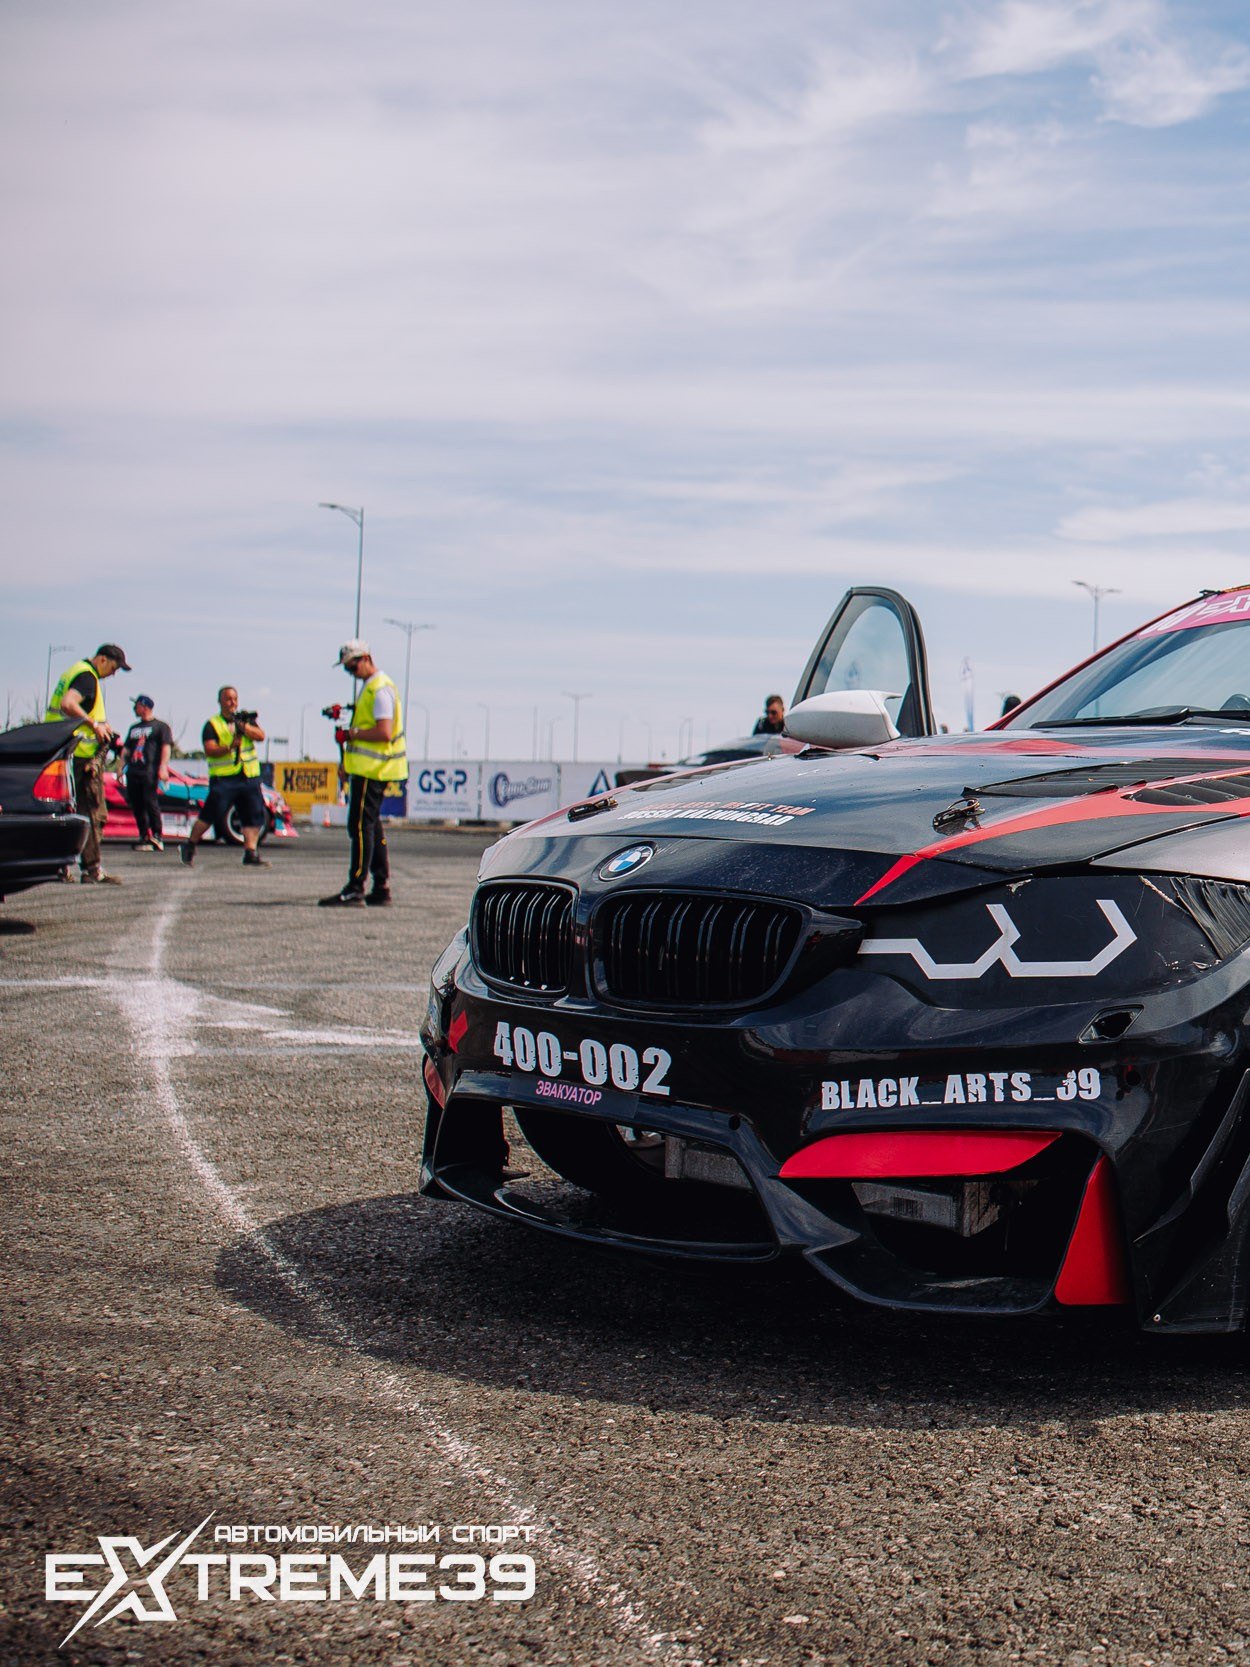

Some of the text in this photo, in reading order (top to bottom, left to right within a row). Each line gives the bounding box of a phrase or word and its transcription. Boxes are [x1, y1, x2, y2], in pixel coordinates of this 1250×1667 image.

[772, 804, 816, 816] TEAM
[493, 1020, 672, 1096] 400-002
[535, 1079, 602, 1106] ЭВАКУАТОР
